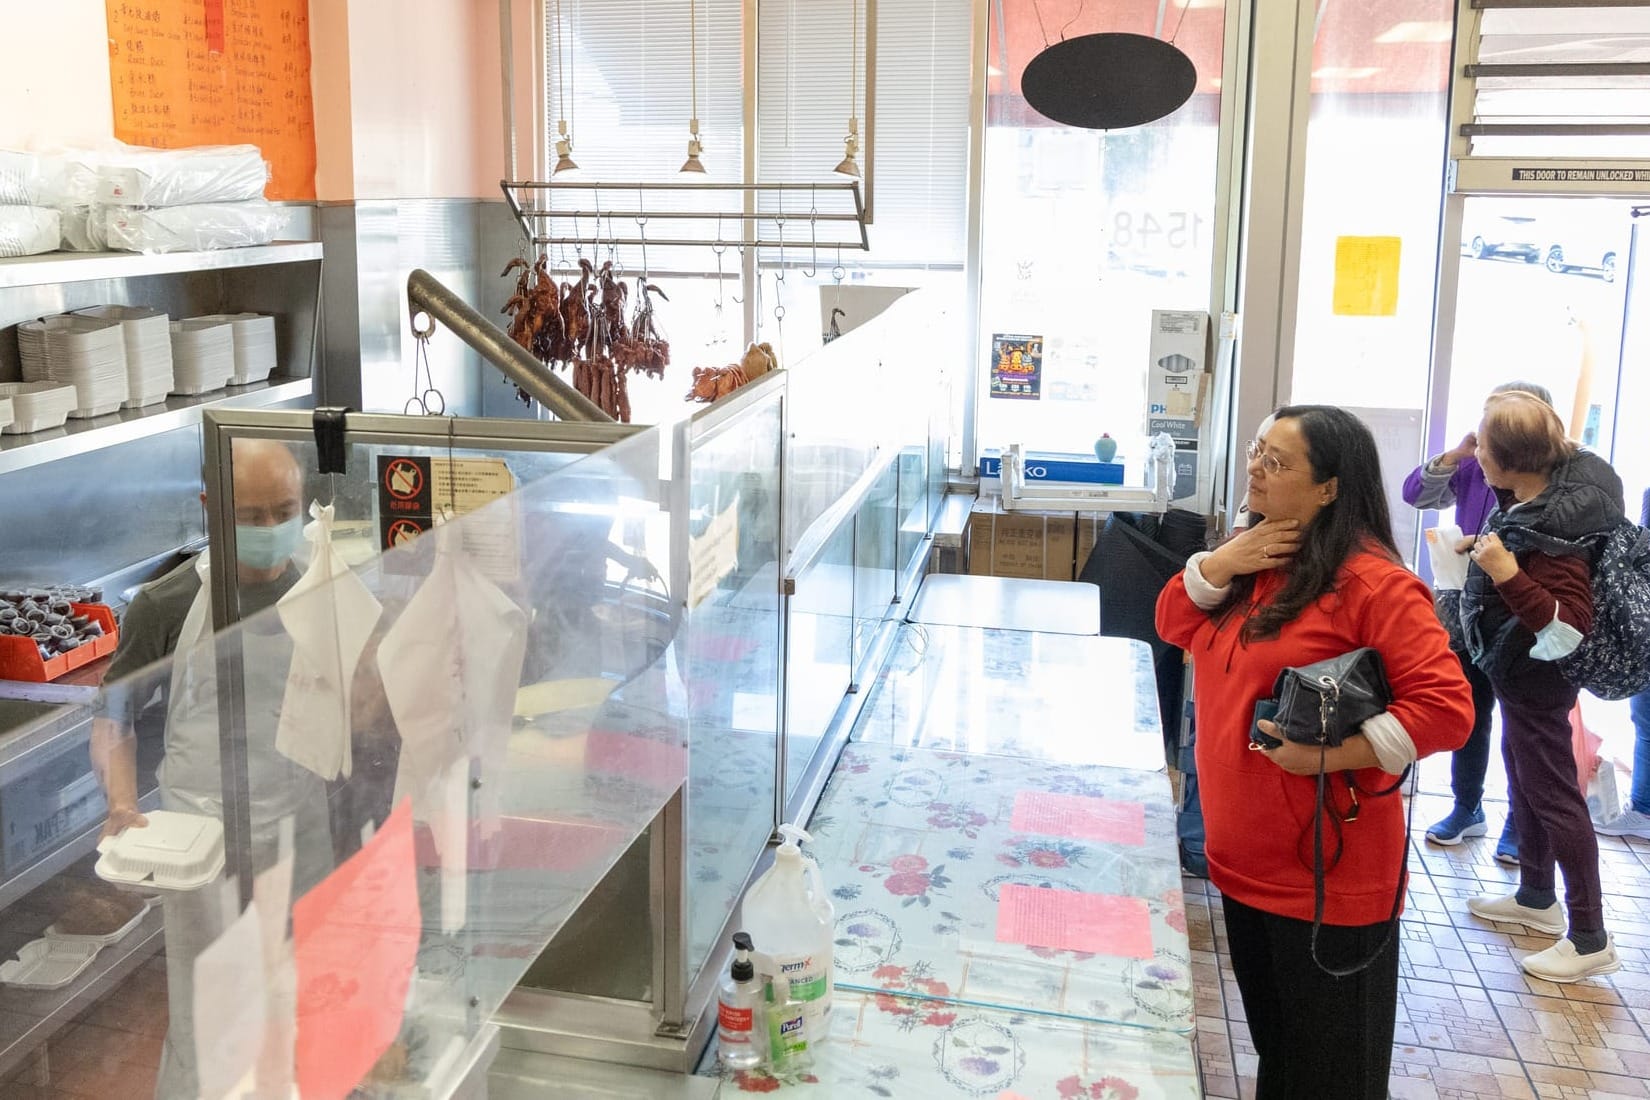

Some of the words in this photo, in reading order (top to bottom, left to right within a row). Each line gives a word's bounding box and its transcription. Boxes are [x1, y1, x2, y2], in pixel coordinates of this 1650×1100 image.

[1519, 170, 1535, 180] THIS
[1536, 170, 1556, 180] DOOR
[1557, 170, 1566, 180] TO
[1567, 170, 1595, 181] REMAIN
[1596, 171, 1633, 181] UNLOCKED
[1151, 420, 1166, 428] Cool
[1166, 420, 1186, 429] White
[986, 461, 1047, 478] Lko
